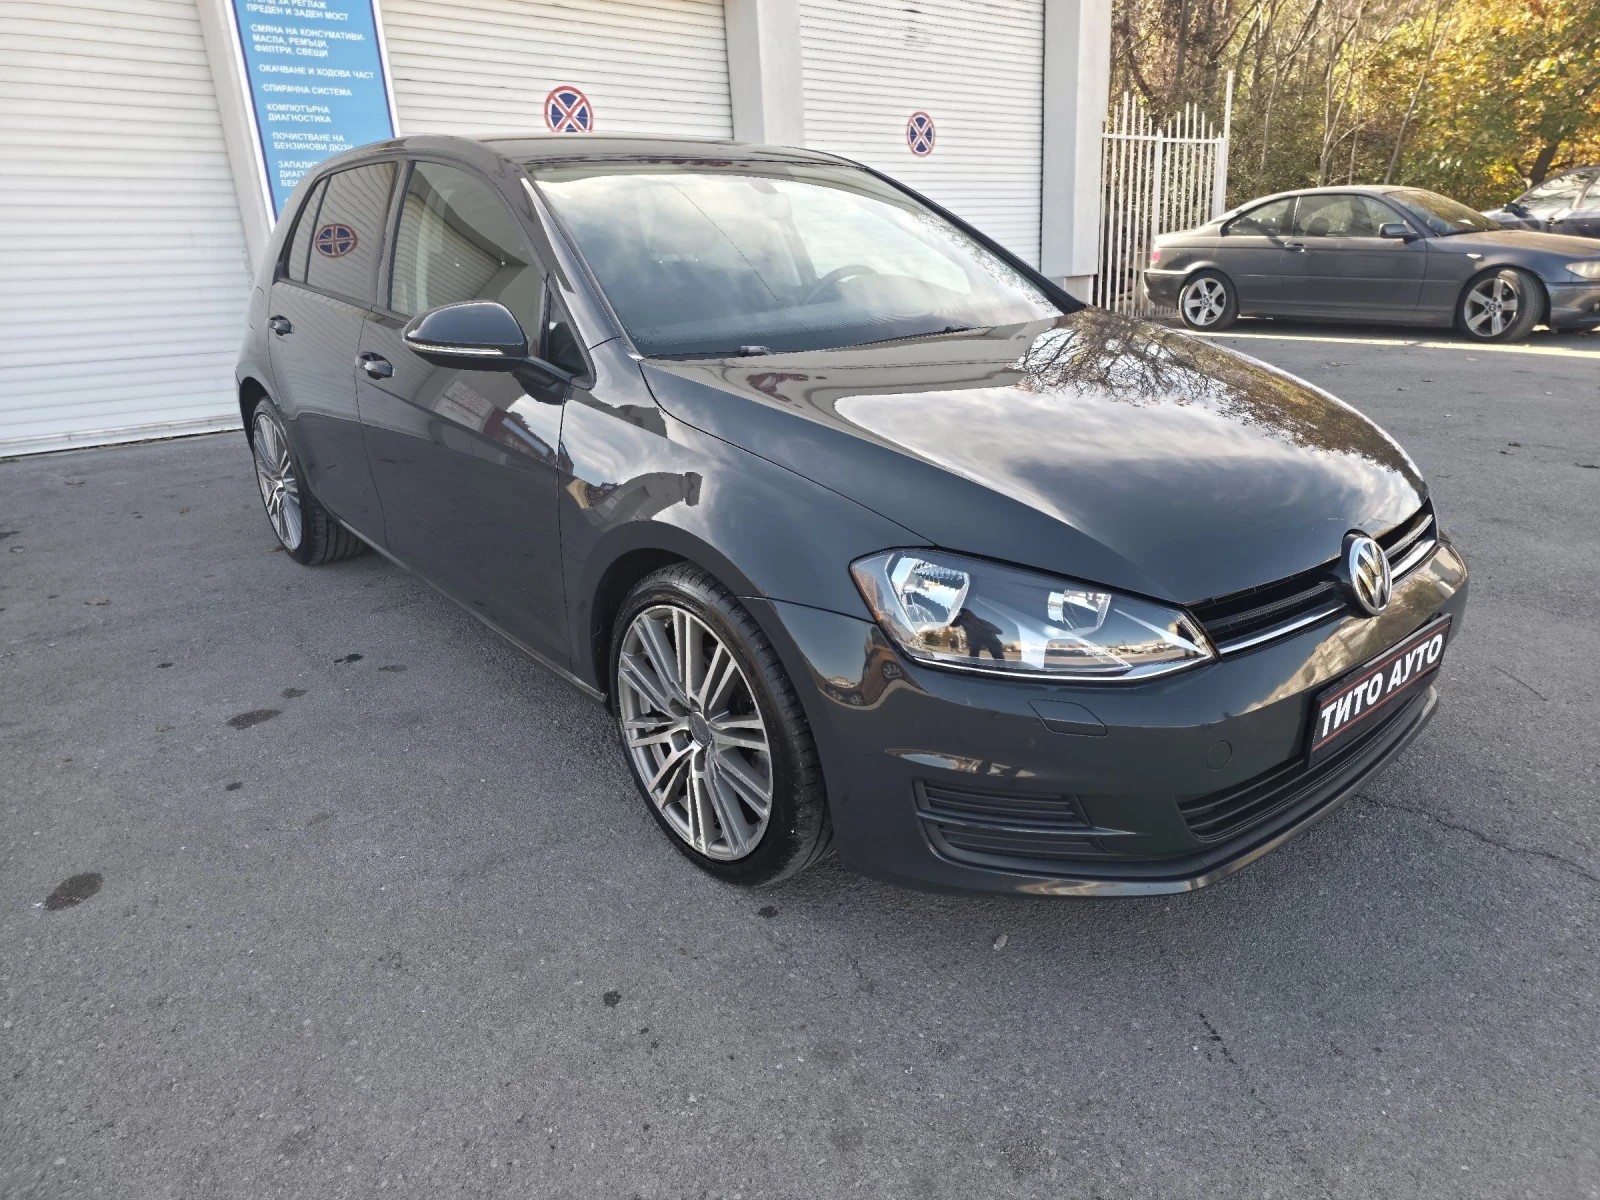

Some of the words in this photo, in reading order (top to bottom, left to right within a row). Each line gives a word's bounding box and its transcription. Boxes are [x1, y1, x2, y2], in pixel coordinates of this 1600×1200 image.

[246, 3, 283, 15] ПРЕДЕН
[294, 8, 323, 18] ЗАДЕН
[325, 11, 348, 20] МОСТ
[251, 24, 283, 34] СМЯНА
[285, 27, 298, 35] НА
[300, 29, 366, 41] КОНСУМАТИВИ-
[296, 48, 328, 58] СВЕЩИ
[259, 64, 306, 75] ОКАЧВАНЕ
[308, 67, 314, 75] И
[316, 68, 351, 78] ХОДОВА
[352, 70, 374, 79] ЧАСТ
[262, 83, 310, 94] СПИРАЧНА
[311, 87, 352, 96] СИСТЕМА
[266, 103, 330, 114] КОМПЮТЪРНА
[268, 113, 332, 123] ДИАГНОСТИКА
[272, 132, 330, 141] ПОЧИСТВАНЕ
[332, 134, 345, 142] НА
[273, 141, 327, 151] БЕНЗИНОВИ
[329, 143, 354, 152] ДЮЗИ
[278, 160, 319, 168] ЗАПАЛИТ
[1321, 672, 1383, 738] ТИТО
[1386, 633, 1444, 694] АУТО
